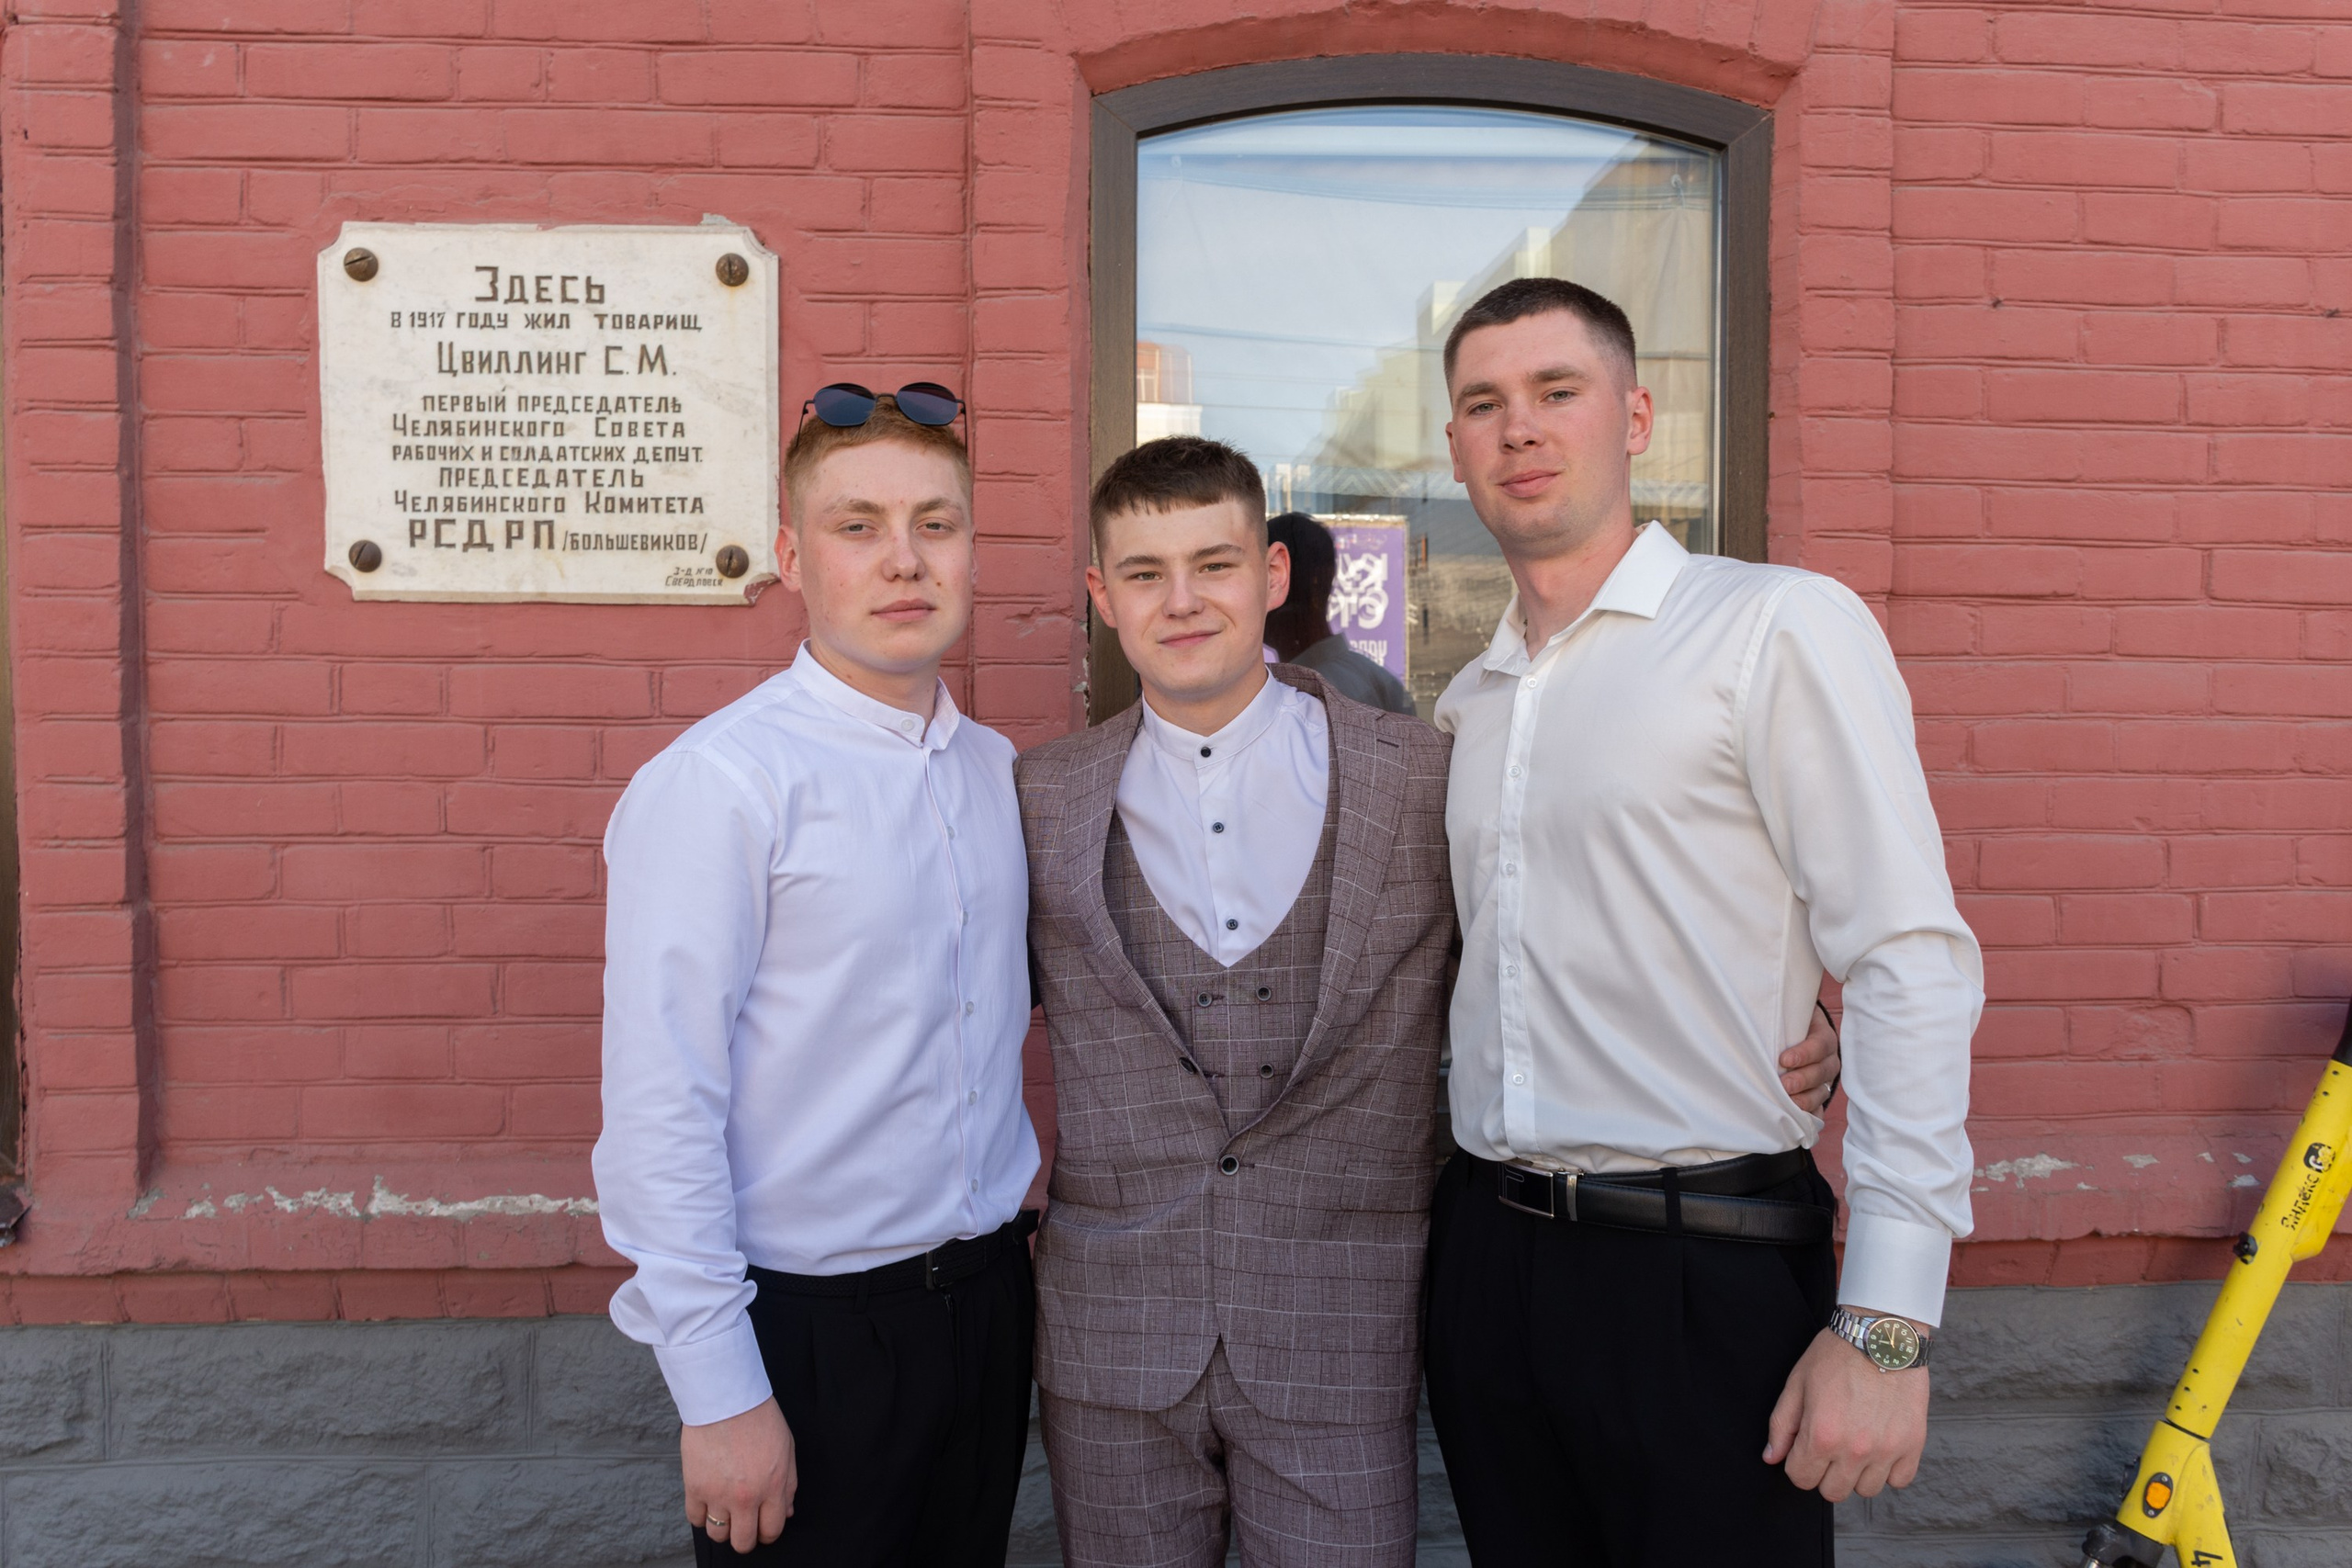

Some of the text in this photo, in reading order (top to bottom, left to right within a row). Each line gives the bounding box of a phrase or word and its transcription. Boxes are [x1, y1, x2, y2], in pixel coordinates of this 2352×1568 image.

[475, 265, 605, 304] ЗДЕСЬ
[410, 311, 446, 329] 1917
[457, 312, 508, 330] ГОДУ
[525, 313, 571, 330] ЖИЛ
[594, 313, 702, 332] ТОВАРИЩ
[423, 386, 505, 412] ПЕРВЫЙ
[392, 445, 474, 461] РАБОЧИХ
[481, 446, 492, 461] И
[439, 467, 644, 490] ПРЕДСЕДАТЕЛЬ
